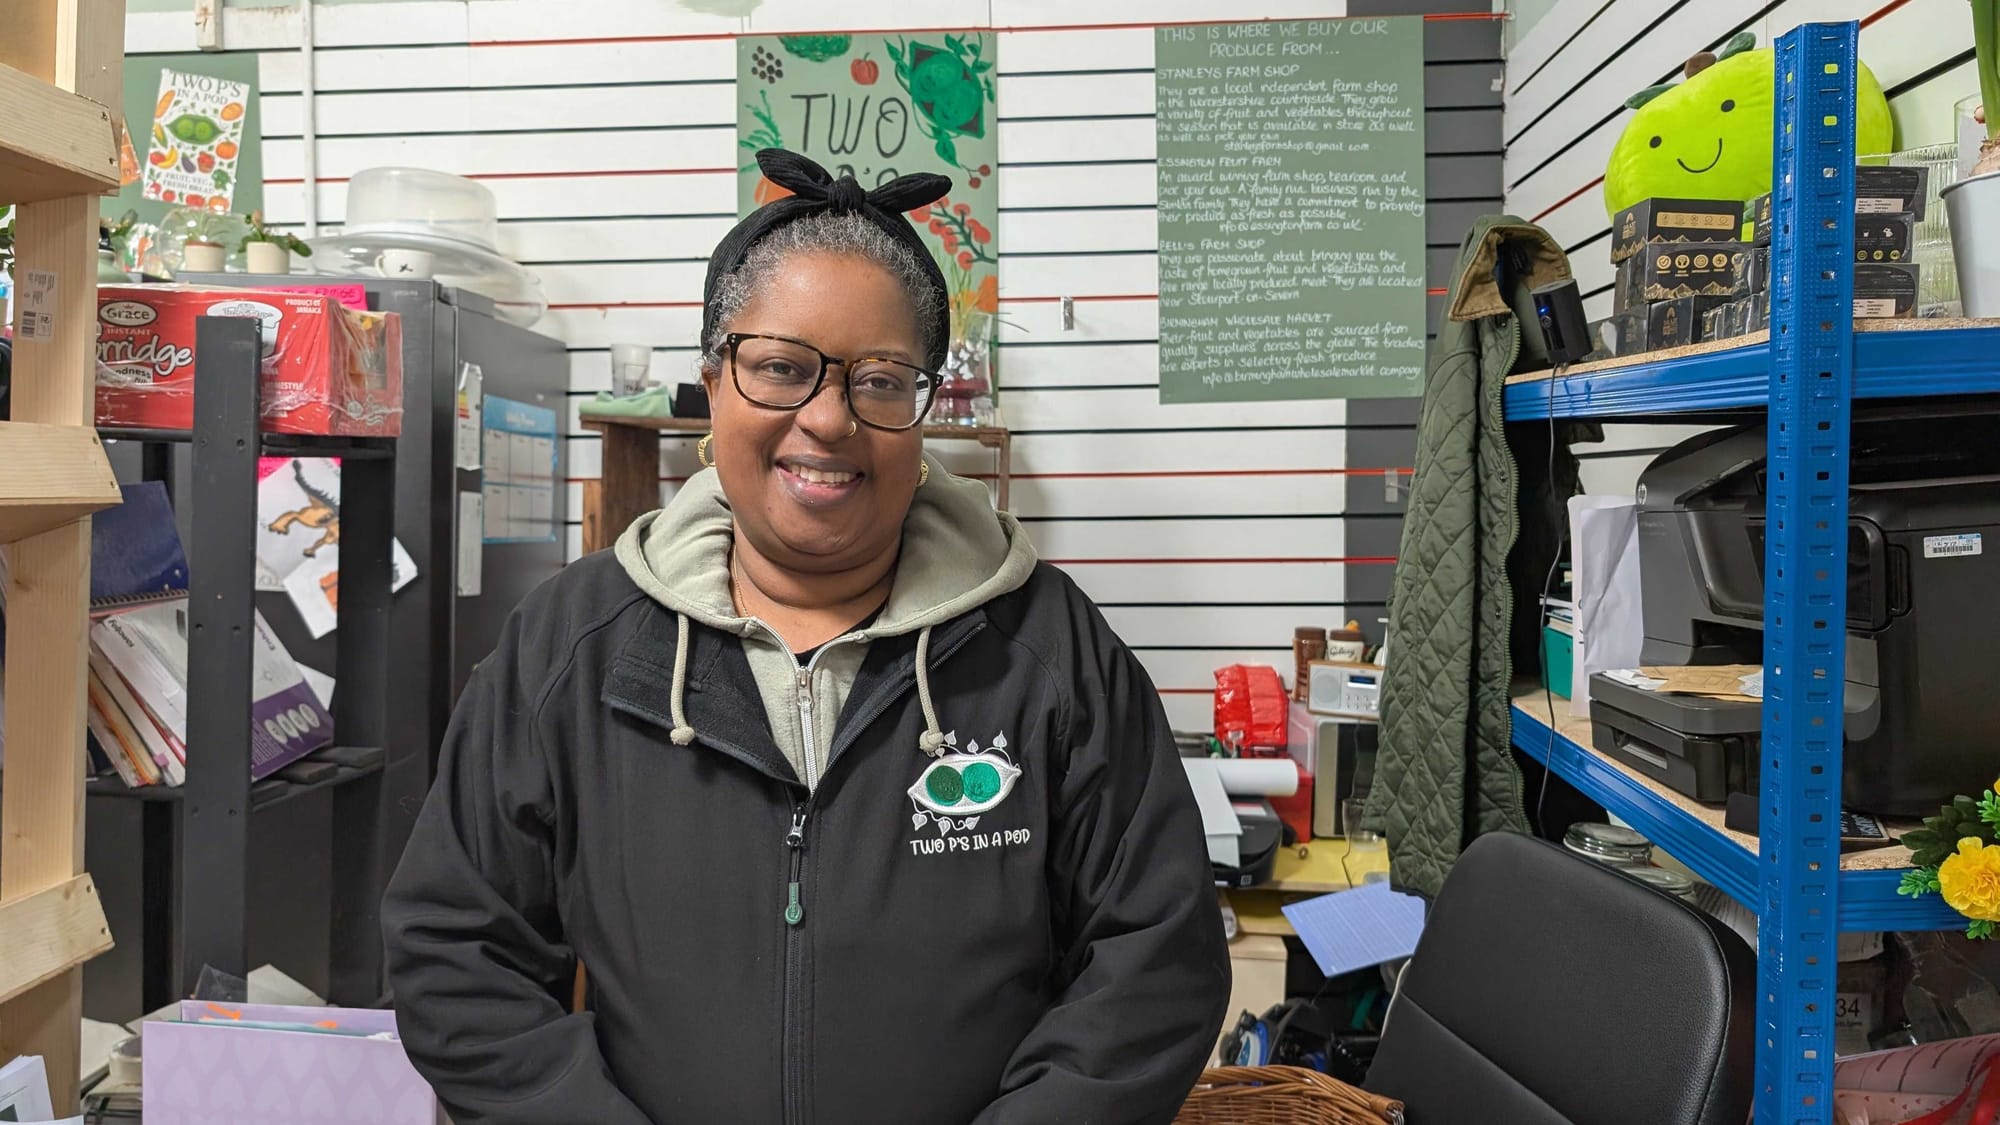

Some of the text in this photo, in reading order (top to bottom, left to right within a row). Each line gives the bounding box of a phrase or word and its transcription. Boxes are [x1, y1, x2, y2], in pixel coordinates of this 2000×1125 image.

[1160, 20, 1388, 42] THIS IS WHERE WE BUY OUR
[1209, 42, 1276, 58] PRODUCE
[1226, 64, 1260, 79] FARM
[1264, 64, 1300, 78] SHOP
[1158, 86, 1182, 99] They
[1188, 86, 1206, 96] are
[1210, 86, 1219, 94] a
[1225, 82, 1254, 94] local
[1333, 78, 1362, 94] farm
[1364, 80, 1398, 96] shop
[1168, 98, 1185, 108] the
[1341, 94, 1366, 109] They
[1367, 96, 1398, 109] grow
[1208, 109, 1222, 122] of
[1223, 108, 1251, 121] fruit
[1256, 106, 1279, 118] and
[1285, 106, 1344, 121] vegetables
[1347, 106, 1413, 124] throughout
[791, 93, 908, 158] TWO
[1220, 120, 1244, 131] that
[1248, 122, 1259, 130] is
[1263, 120, 1320, 131] available
[1323, 122, 1332, 130] in
[1389, 121, 1416, 132] well
[1252, 156, 1281, 167] FARM
[1177, 170, 1215, 182] award
[1220, 172, 1259, 187] winning
[1262, 168, 1290, 182] farm
[1381, 171, 1407, 183] and
[1238, 183, 1247, 194] A
[1249, 184, 1282, 198] family
[1285, 184, 1306, 194] run
[1311, 183, 1358, 196] business
[1362, 186, 1381, 196] run
[1385, 185, 1398, 201] by
[1400, 186, 1420, 198] the
[1231, 212, 1245, 221] as
[1247, 208, 1274, 222] fresh
[1279, 210, 1295, 218] as
[1256, 197, 1280, 206] have
[1285, 198, 1292, 206] a
[1365, 198, 1377, 209] to
[1379, 202, 1424, 217] providing
[1200, 238, 1265, 250] FARM SHOP
[1208, 251, 1265, 265] passionate
[1273, 250, 1304, 262] about
[1311, 249, 1352, 266] bringing
[1354, 252, 1375, 266] you
[1379, 250, 1399, 262] the
[1192, 265, 1205, 280] of
[1263, 262, 1288, 278] fruit
[1294, 263, 1317, 274] and
[1321, 262, 1379, 275] vegetables
[1383, 261, 1406, 274] and
[1213, 278, 1247, 293] locally
[1249, 276, 1298, 290] produced
[1328, 274, 1356, 290] They
[1378, 276, 1423, 288] located
[106, 307, 150, 320] Grace
[107, 328, 151, 336] INSTANT
[1186, 330, 1214, 344] fruit
[1218, 328, 1239, 340] and
[1243, 326, 1300, 343] vegetables
[1306, 328, 1325, 337] are
[1331, 322, 1379, 336] sourced
[1382, 322, 1408, 336] from
[1161, 344, 1197, 360] quality
[1203, 342, 1256, 356] suppliers
[1263, 341, 1300, 352] across
[1306, 338, 1320, 350] the
[1324, 337, 1357, 353] globe
[1361, 336, 1379, 348] The
[1181, 357, 1221, 372] experts
[1224, 358, 1234, 367] in
[1238, 355, 1291, 370] selecting
[1293, 352, 1325, 368] fresh
[1329, 350, 1377, 364] produce
[910, 828, 1031, 856] TWO P'S IN A POD
